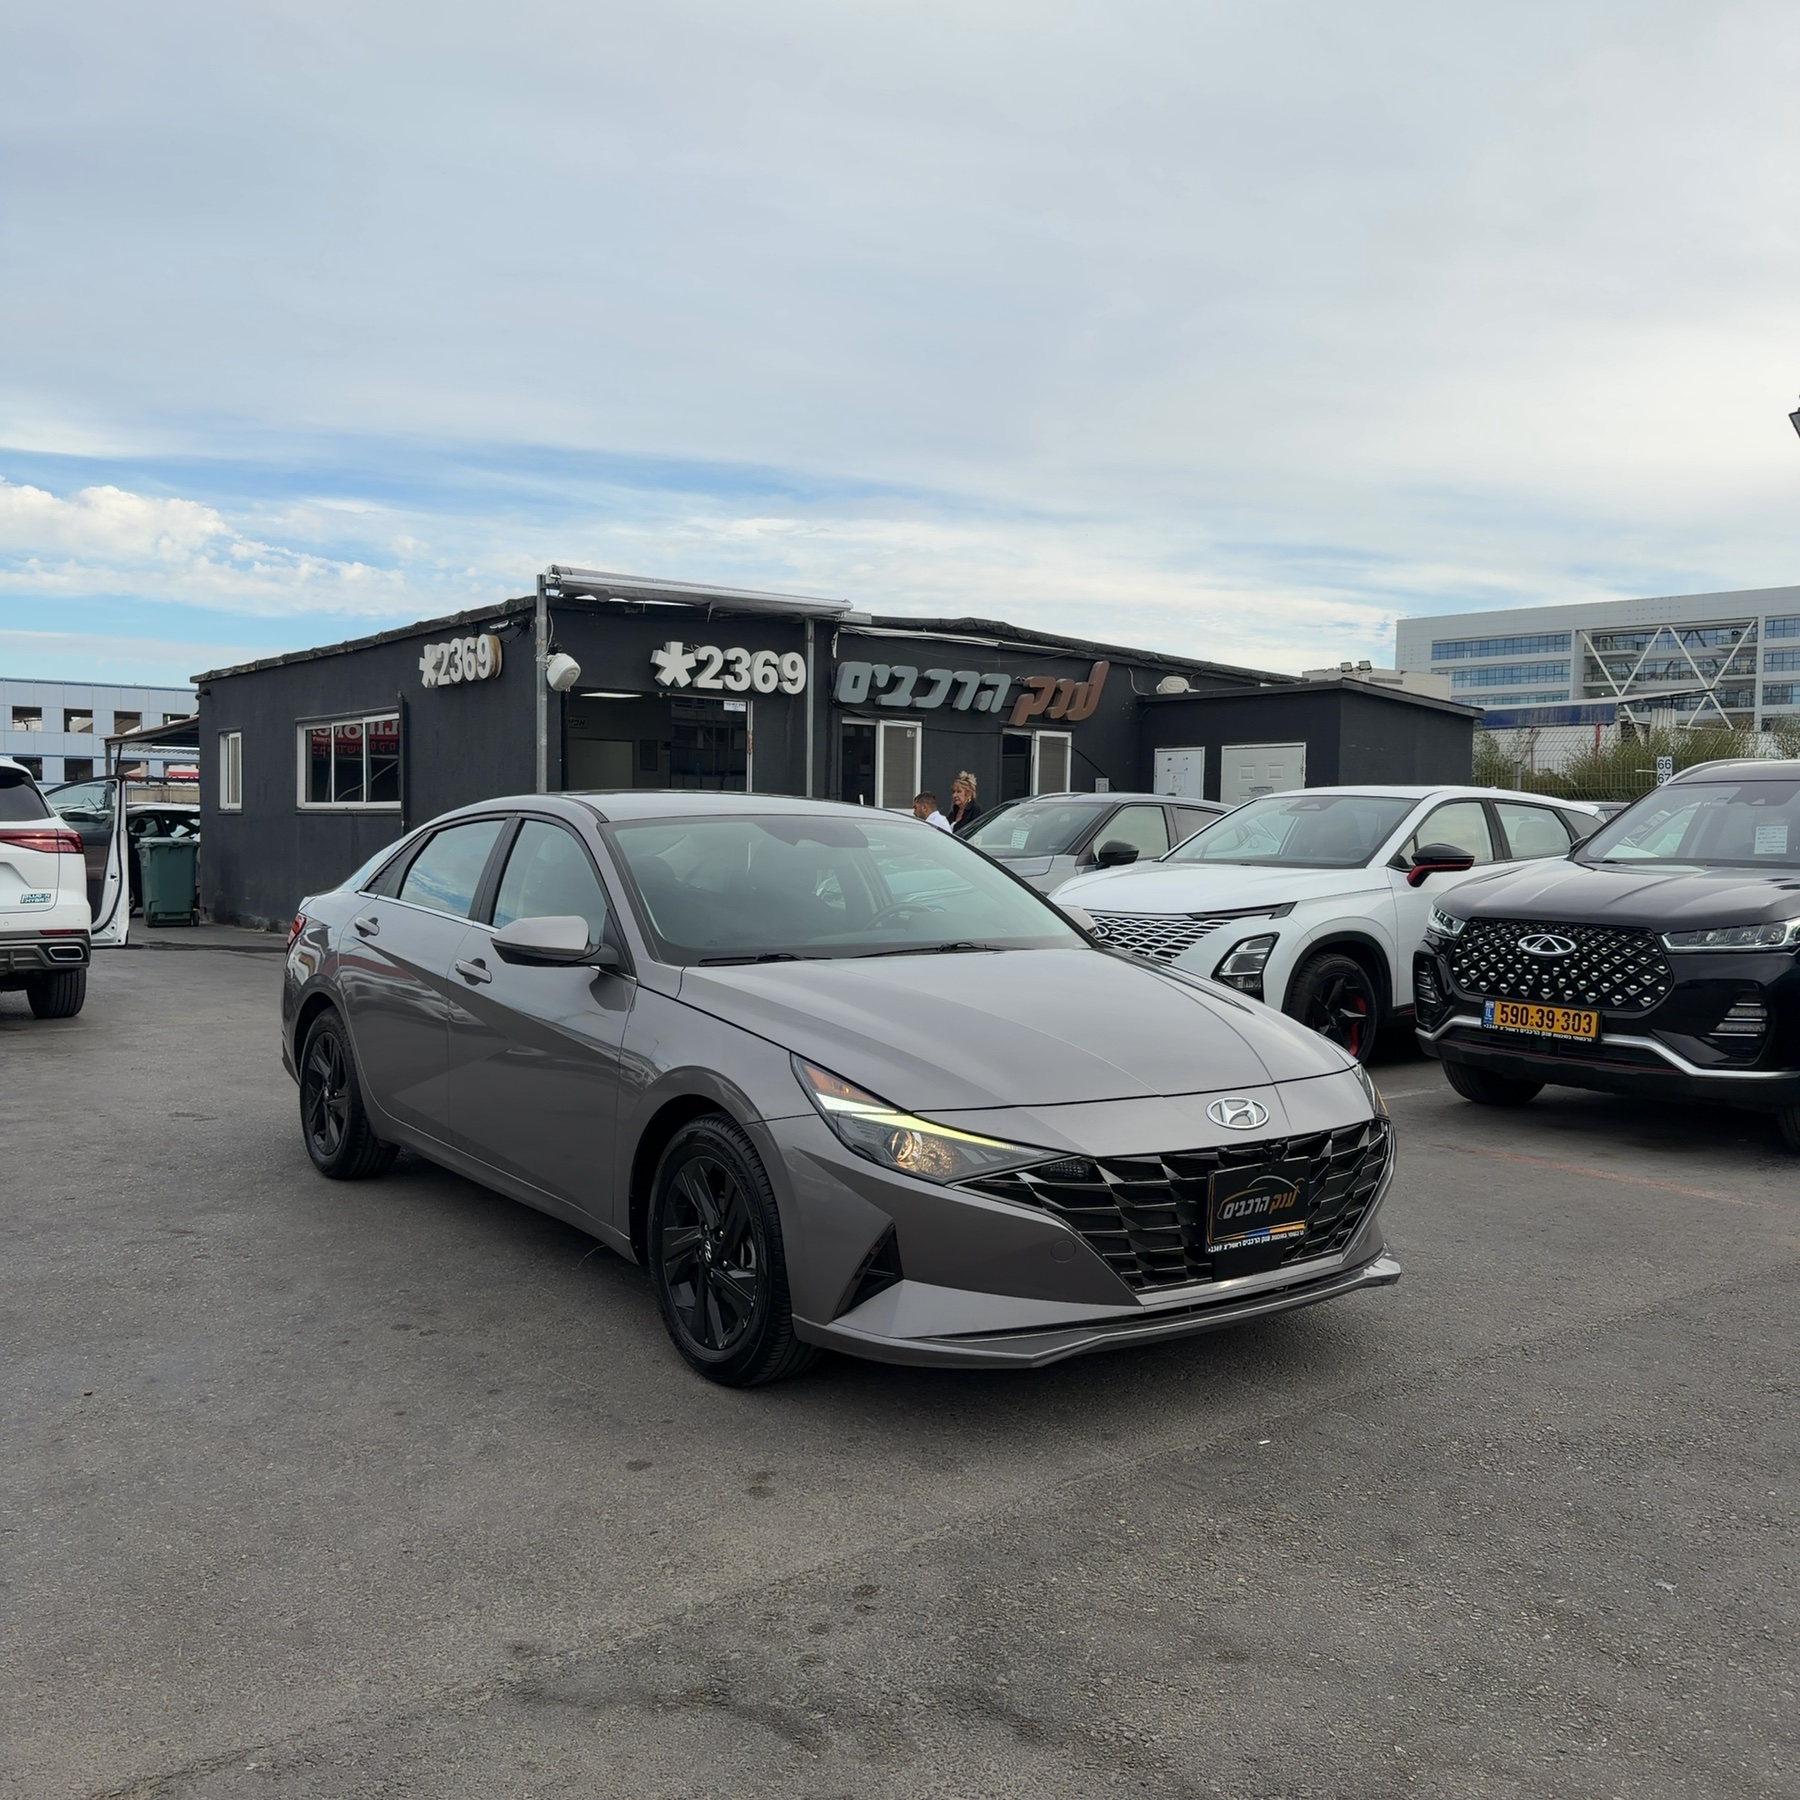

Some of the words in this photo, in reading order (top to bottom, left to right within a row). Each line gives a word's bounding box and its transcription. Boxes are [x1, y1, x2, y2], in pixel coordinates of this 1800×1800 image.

[834, 661, 1010, 714] הרכבים
[1008, 660, 1110, 726] ענק
[1658, 759, 1671, 769] 66
[1658, 773, 1671, 784] 67
[1223, 1196, 1271, 1220] הרכבים
[1268, 1185, 1300, 1215] ענק
